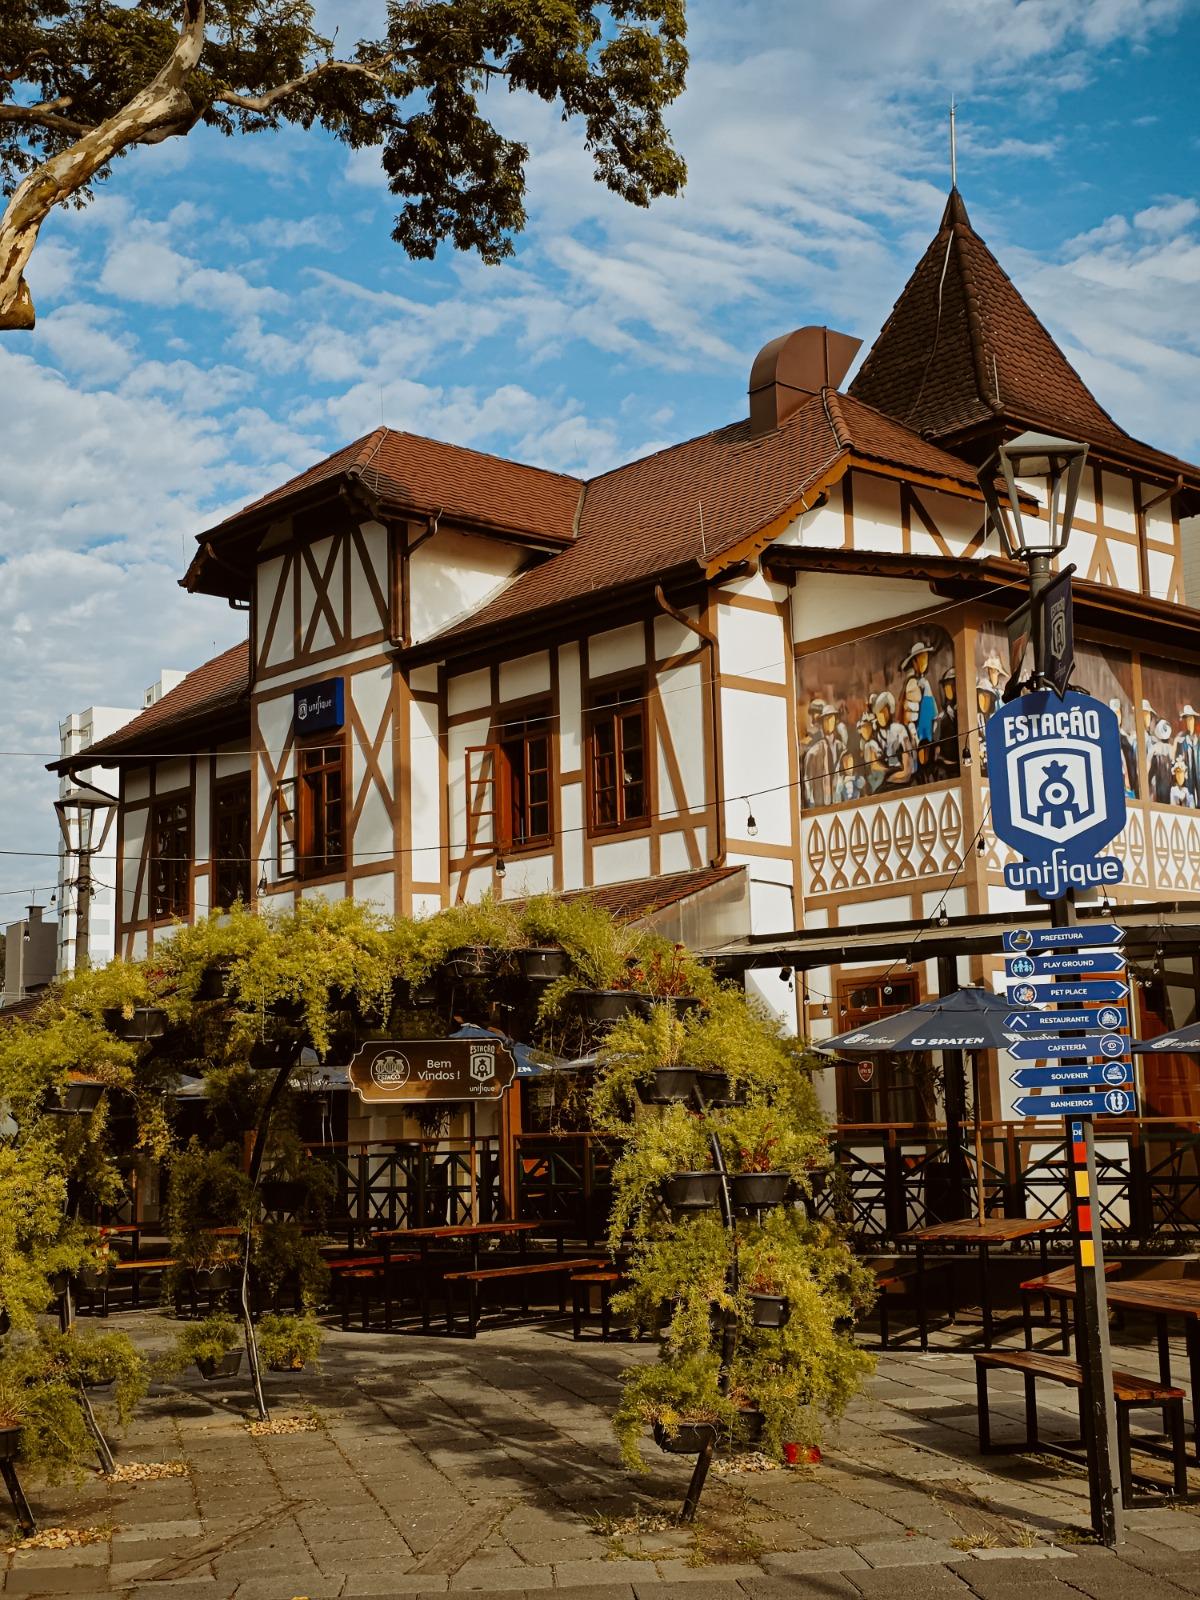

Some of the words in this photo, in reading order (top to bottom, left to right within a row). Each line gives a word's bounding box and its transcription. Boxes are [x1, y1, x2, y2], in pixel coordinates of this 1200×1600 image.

[1003, 706, 1100, 748] ESTAÇÃO
[1008, 848, 1119, 895] unifique
[1040, 933, 1084, 942] PREFEITURA
[1061, 960, 1095, 968] GROUND
[1064, 988, 1088, 996] PLACE
[1039, 1016, 1090, 1024] RESTAURANTE
[927, 1037, 985, 1046] SPATEN
[1047, 1044, 1087, 1052] CAFETERIA
[426, 1059, 452, 1069] Bem
[417, 1070, 455, 1080] Vindos
[1050, 1072, 1089, 1080] SOUVENIR
[469, 1082, 496, 1095] unifique
[1050, 1100, 1094, 1108] BANHEIROS
